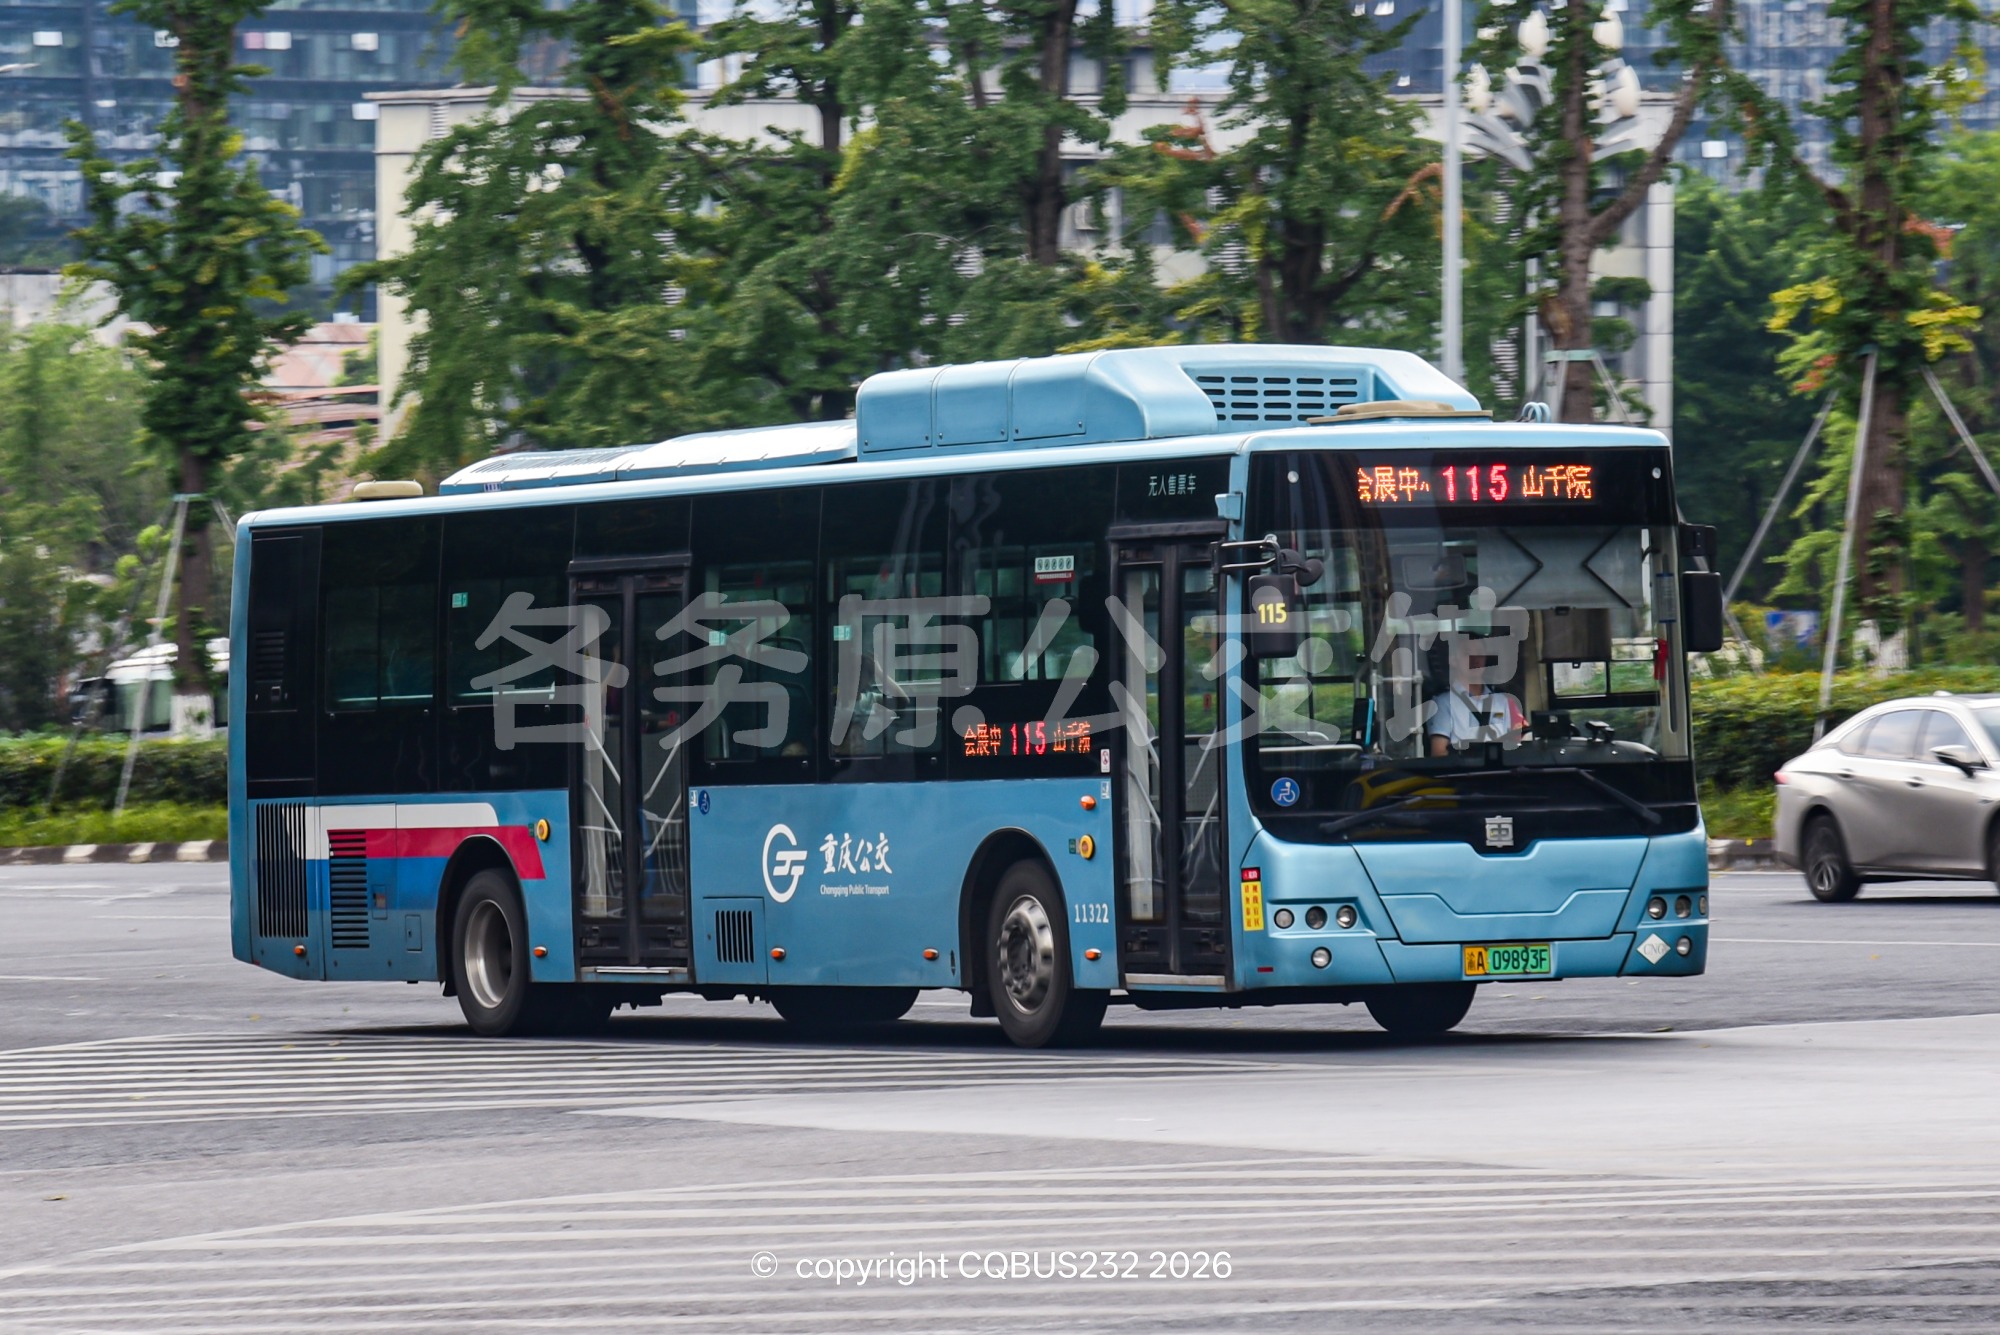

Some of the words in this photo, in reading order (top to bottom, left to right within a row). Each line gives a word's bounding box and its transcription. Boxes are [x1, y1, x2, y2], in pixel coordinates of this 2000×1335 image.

[1148, 473, 1197, 497] 无人售票车
[1443, 465, 1508, 502] 115
[1522, 465, 1592, 499] 山千院
[1258, 602, 1287, 624] 115
[1010, 722, 1046, 756] 115
[820, 832, 893, 875] 重庆公交
[820, 884, 849, 898] Chongqing
[849, 884, 865, 895] Public
[864, 884, 890, 897] Transport
[1074, 903, 1109, 924] 11322
[1643, 943, 1669, 956] CNG
